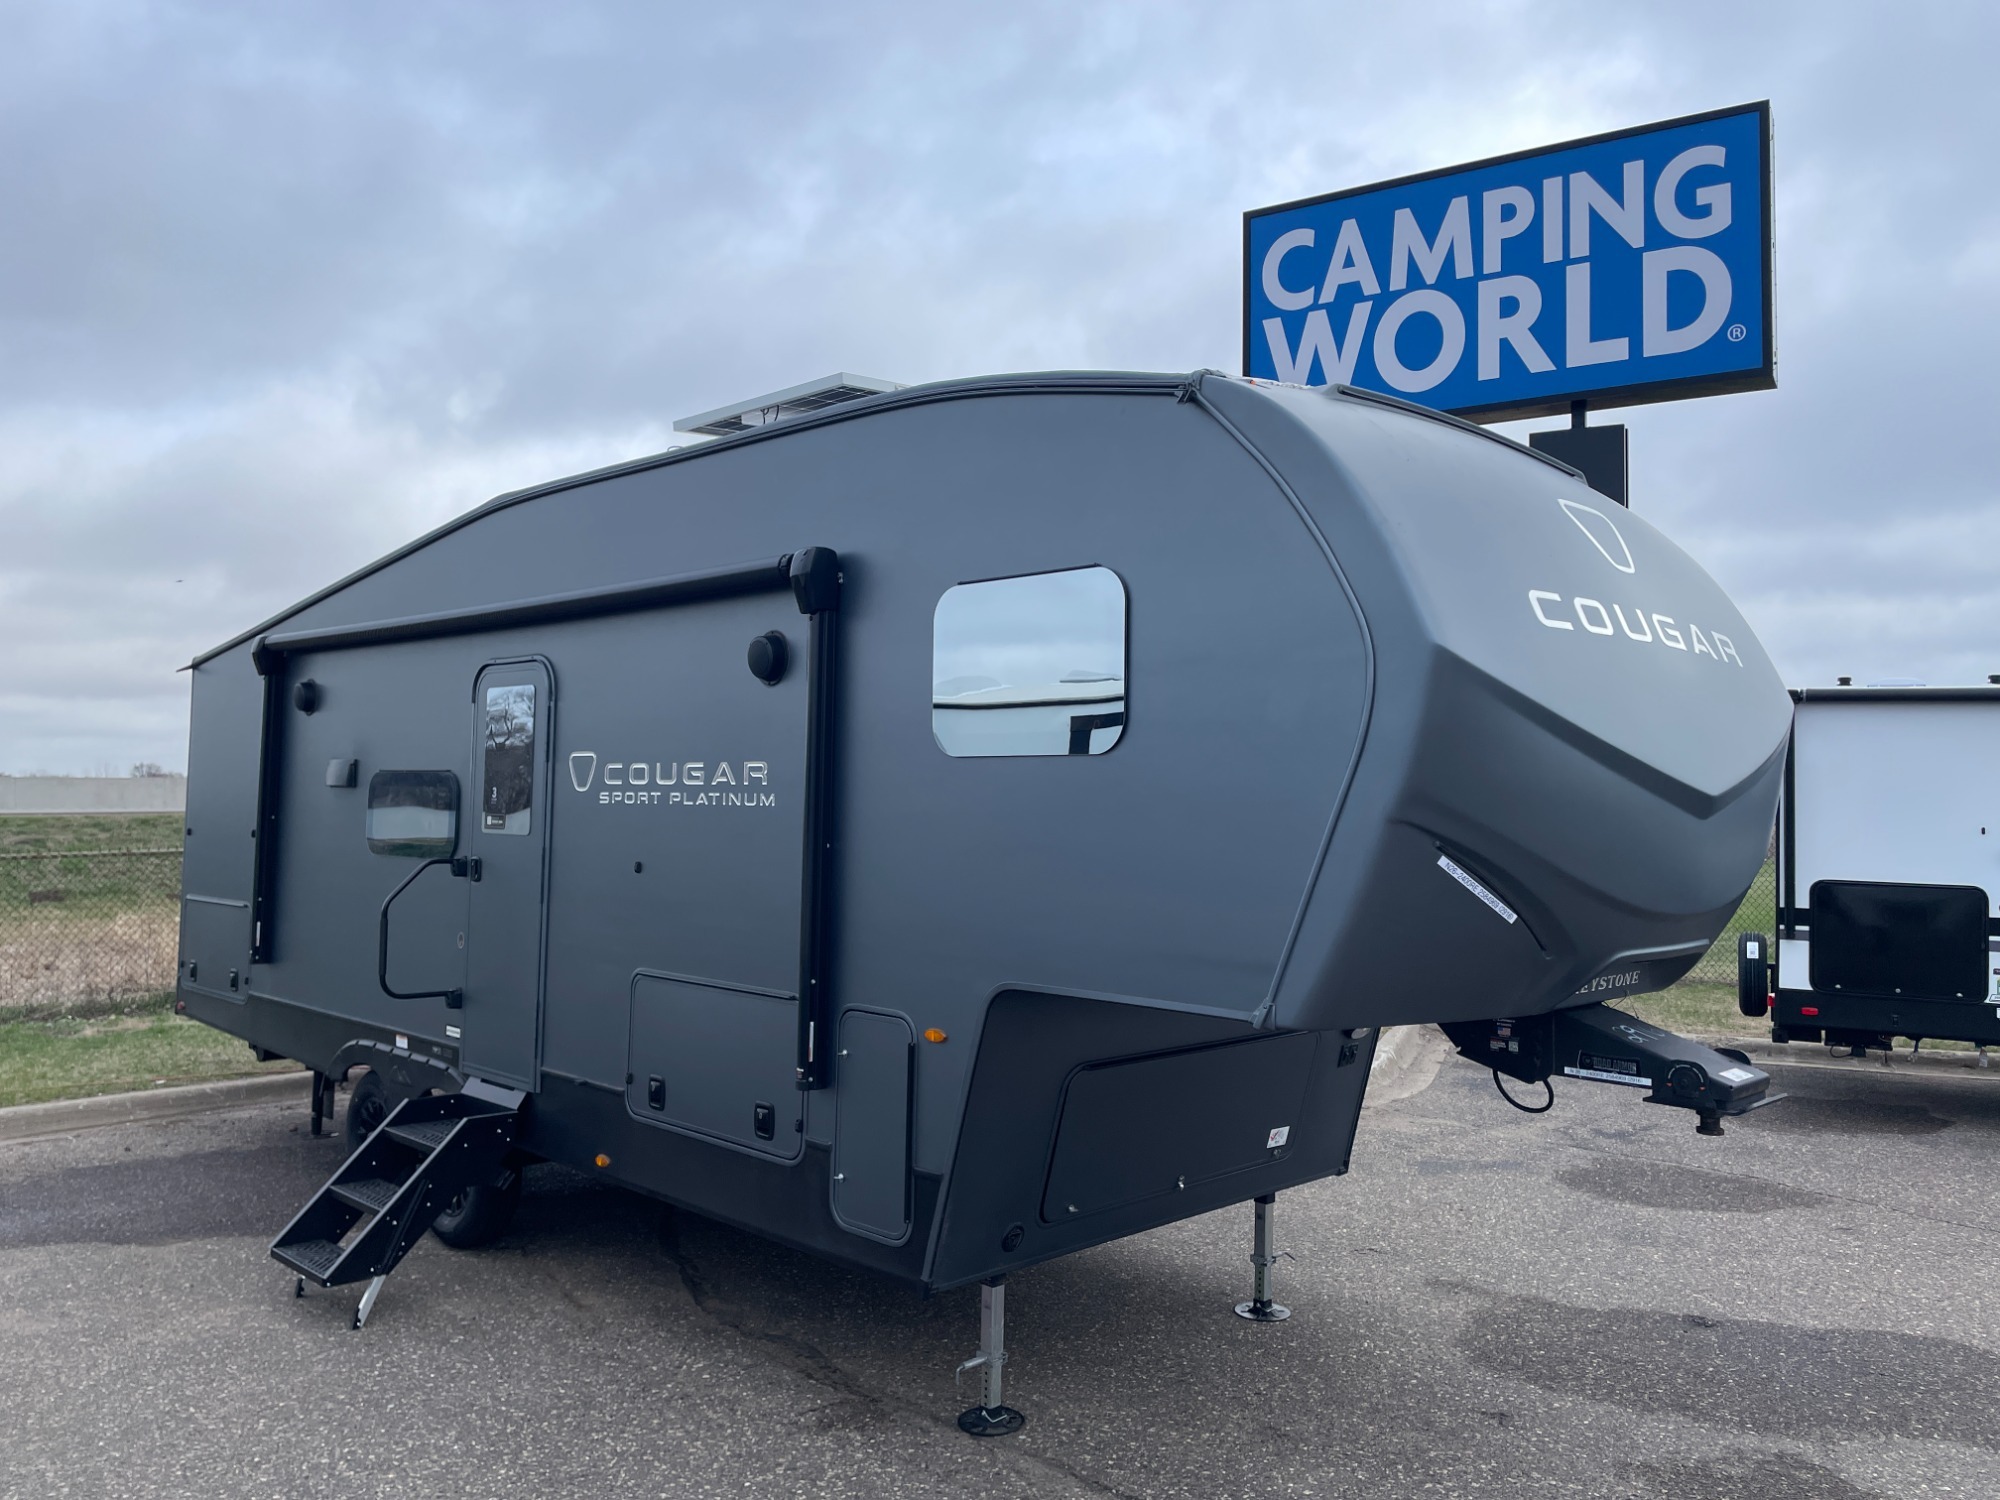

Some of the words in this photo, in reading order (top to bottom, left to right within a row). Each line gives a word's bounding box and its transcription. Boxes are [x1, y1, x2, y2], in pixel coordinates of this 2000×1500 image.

[1262, 145, 1732, 311] CAMPING
[1263, 245, 1732, 393] WORLD
[1528, 589, 1743, 667] COUGAR
[599, 791, 661, 804] SPORT
[669, 792, 776, 807] PLATINUM
[604, 761, 768, 785] COUGAR
